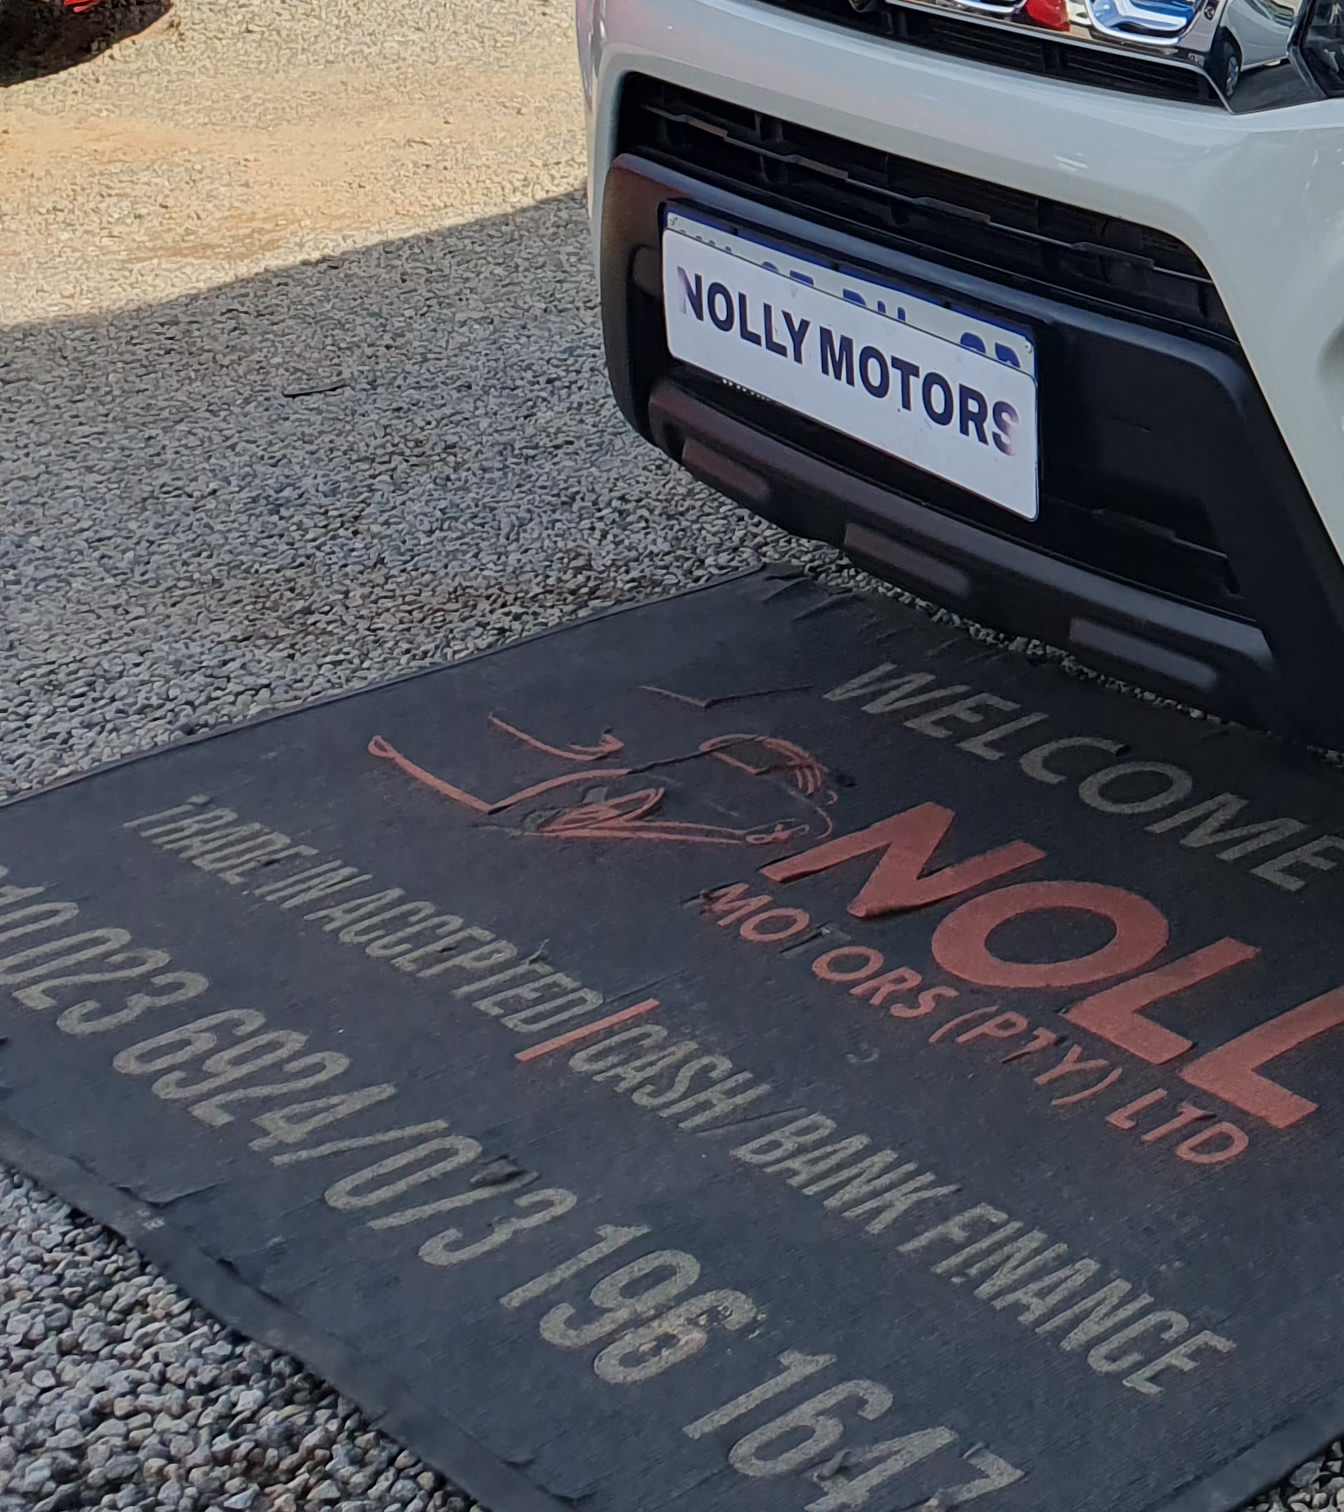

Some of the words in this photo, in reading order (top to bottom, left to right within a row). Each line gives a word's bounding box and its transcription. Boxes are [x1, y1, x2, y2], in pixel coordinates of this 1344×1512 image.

[676, 265, 810, 365] NOLLY
[819, 325, 1021, 457] MOTORS
[122, 794, 319, 885] TRADE
[254, 859, 374, 909] IN
[896, 1202, 1238, 1395] FINANCE
[1104, 1087, 1250, 1165] LTD
[499, 1223, 757, 1386] 196
